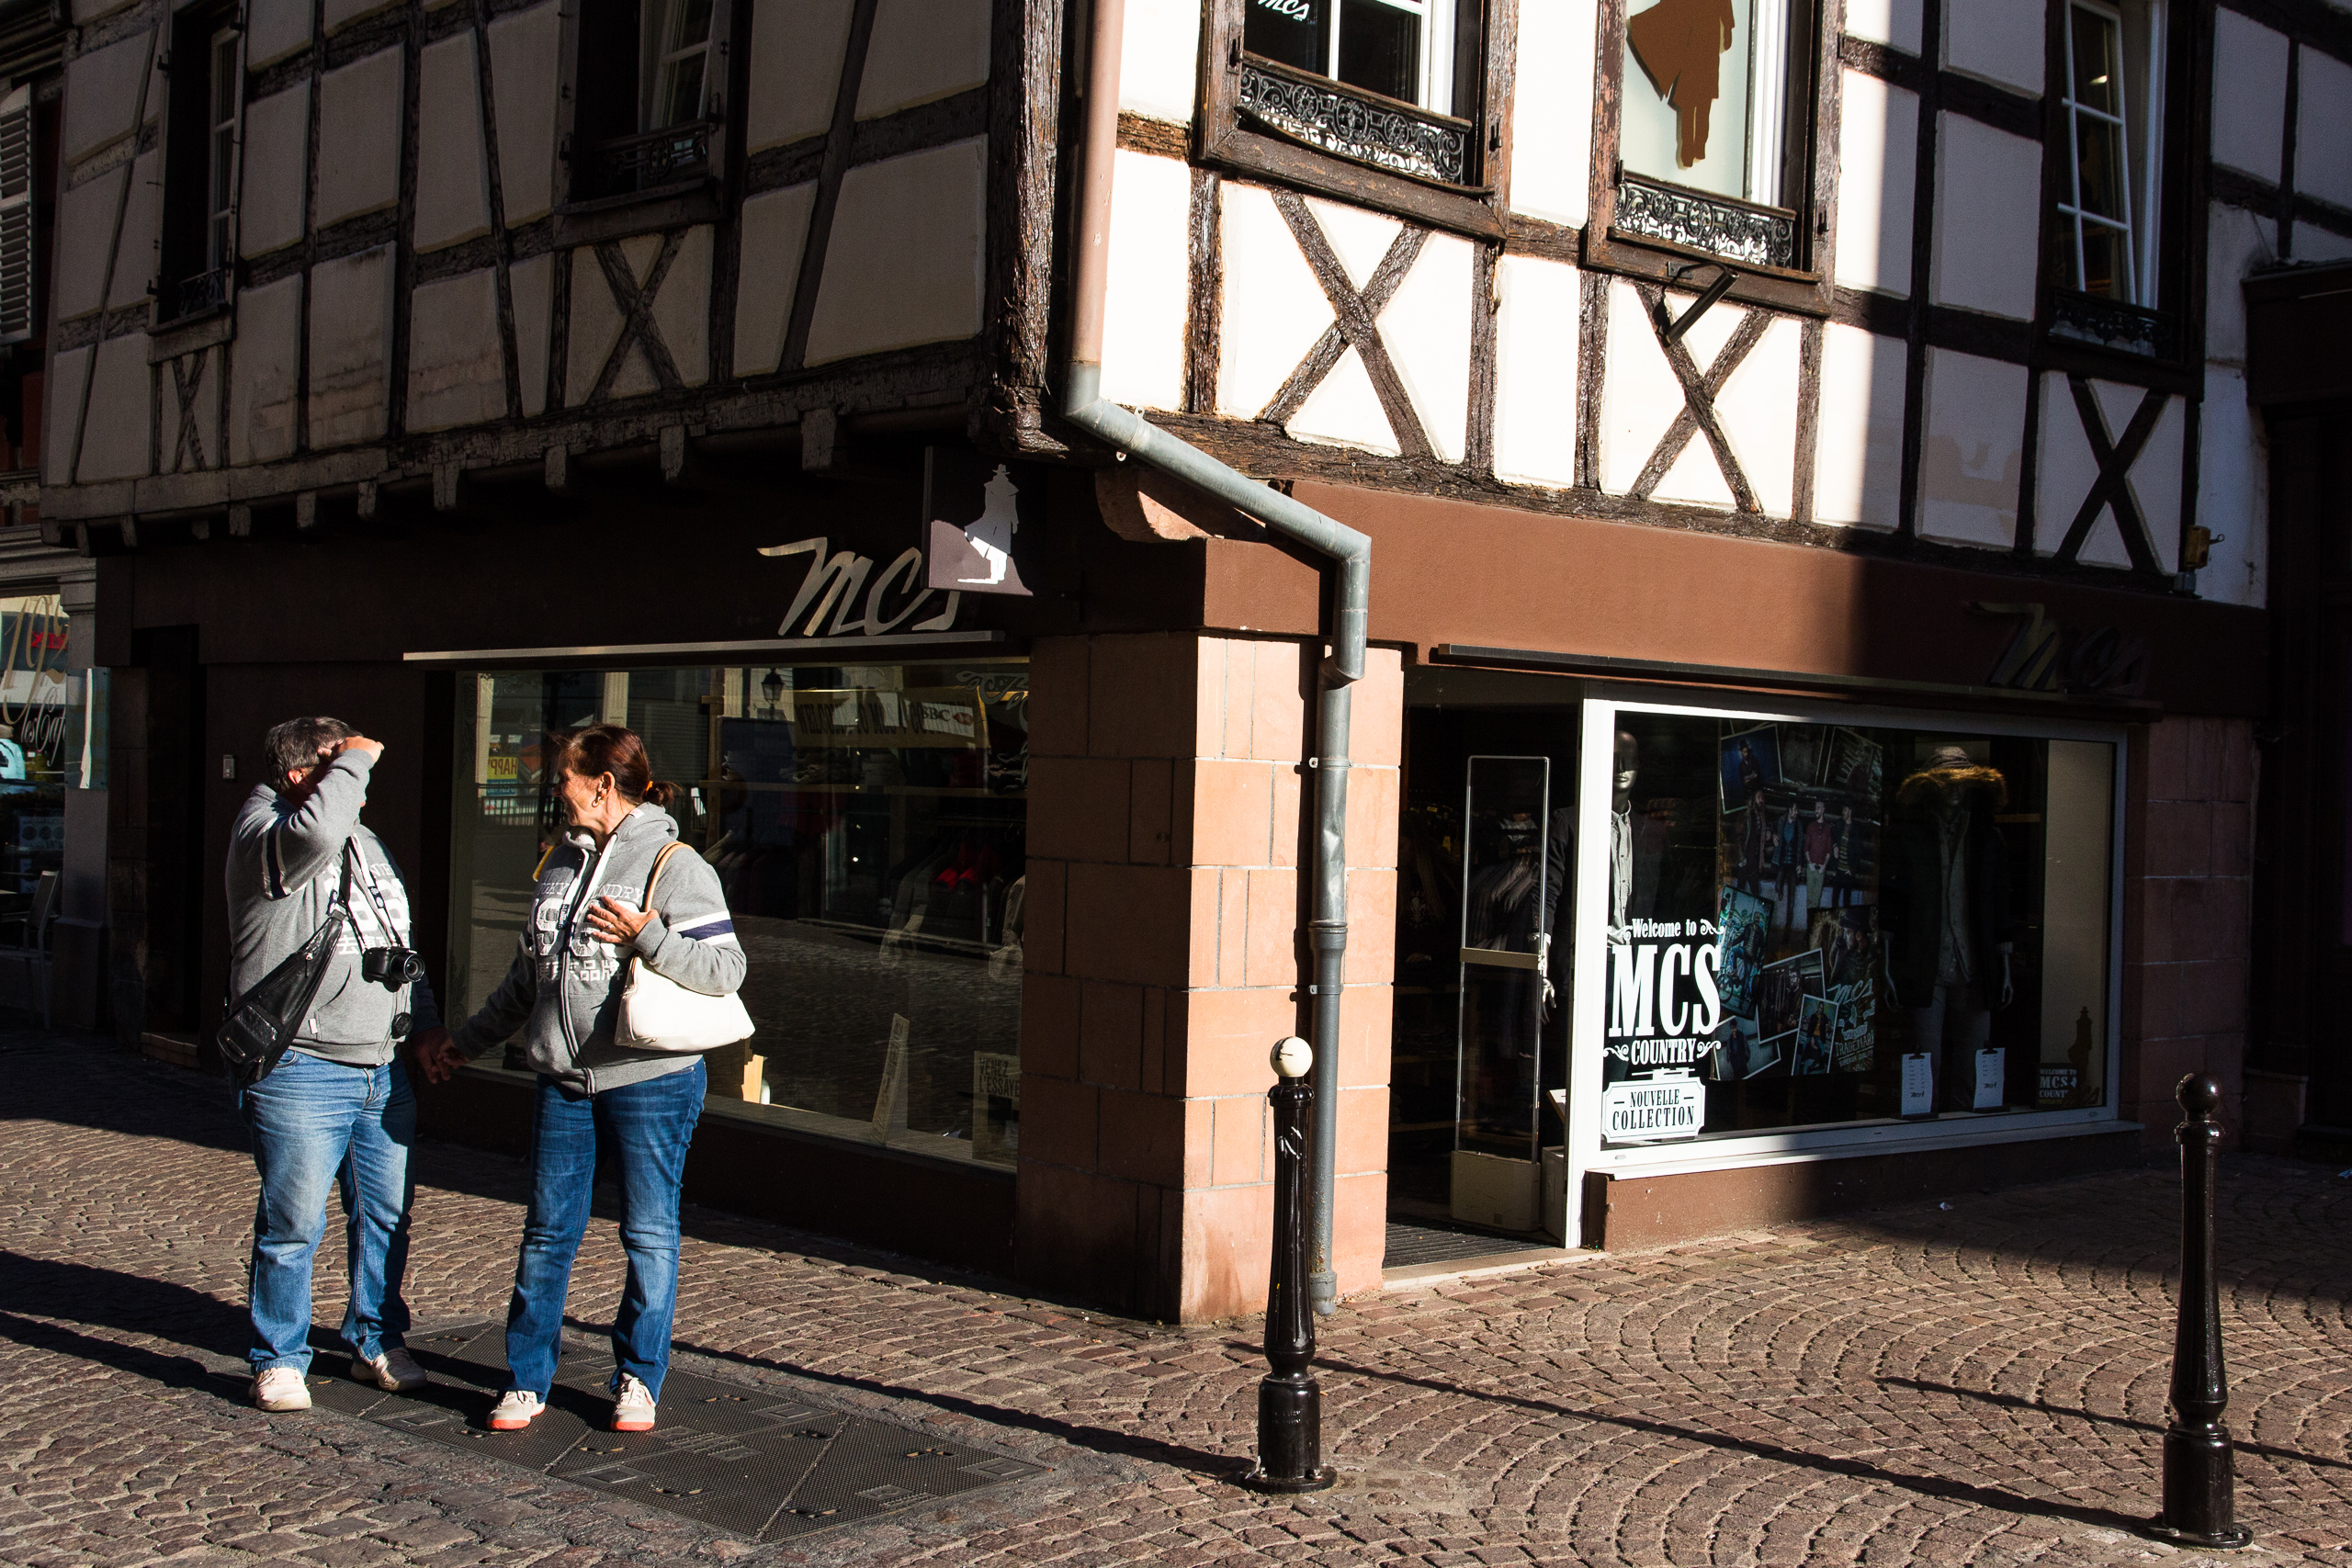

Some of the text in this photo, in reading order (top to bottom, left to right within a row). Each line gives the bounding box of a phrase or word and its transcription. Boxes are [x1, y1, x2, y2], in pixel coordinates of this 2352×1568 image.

[1632, 919, 1697, 939] Welcome to
[1609, 943, 1721, 1037] MCS
[1630, 1038, 1698, 1066] COUNTRY
[2039, 1076, 2069, 1089] MCS
[1630, 1089, 1679, 1108] NOUVELLE
[2039, 1089, 2069, 1099] COUNT
[1611, 1105, 1695, 1132] COLLECTION
